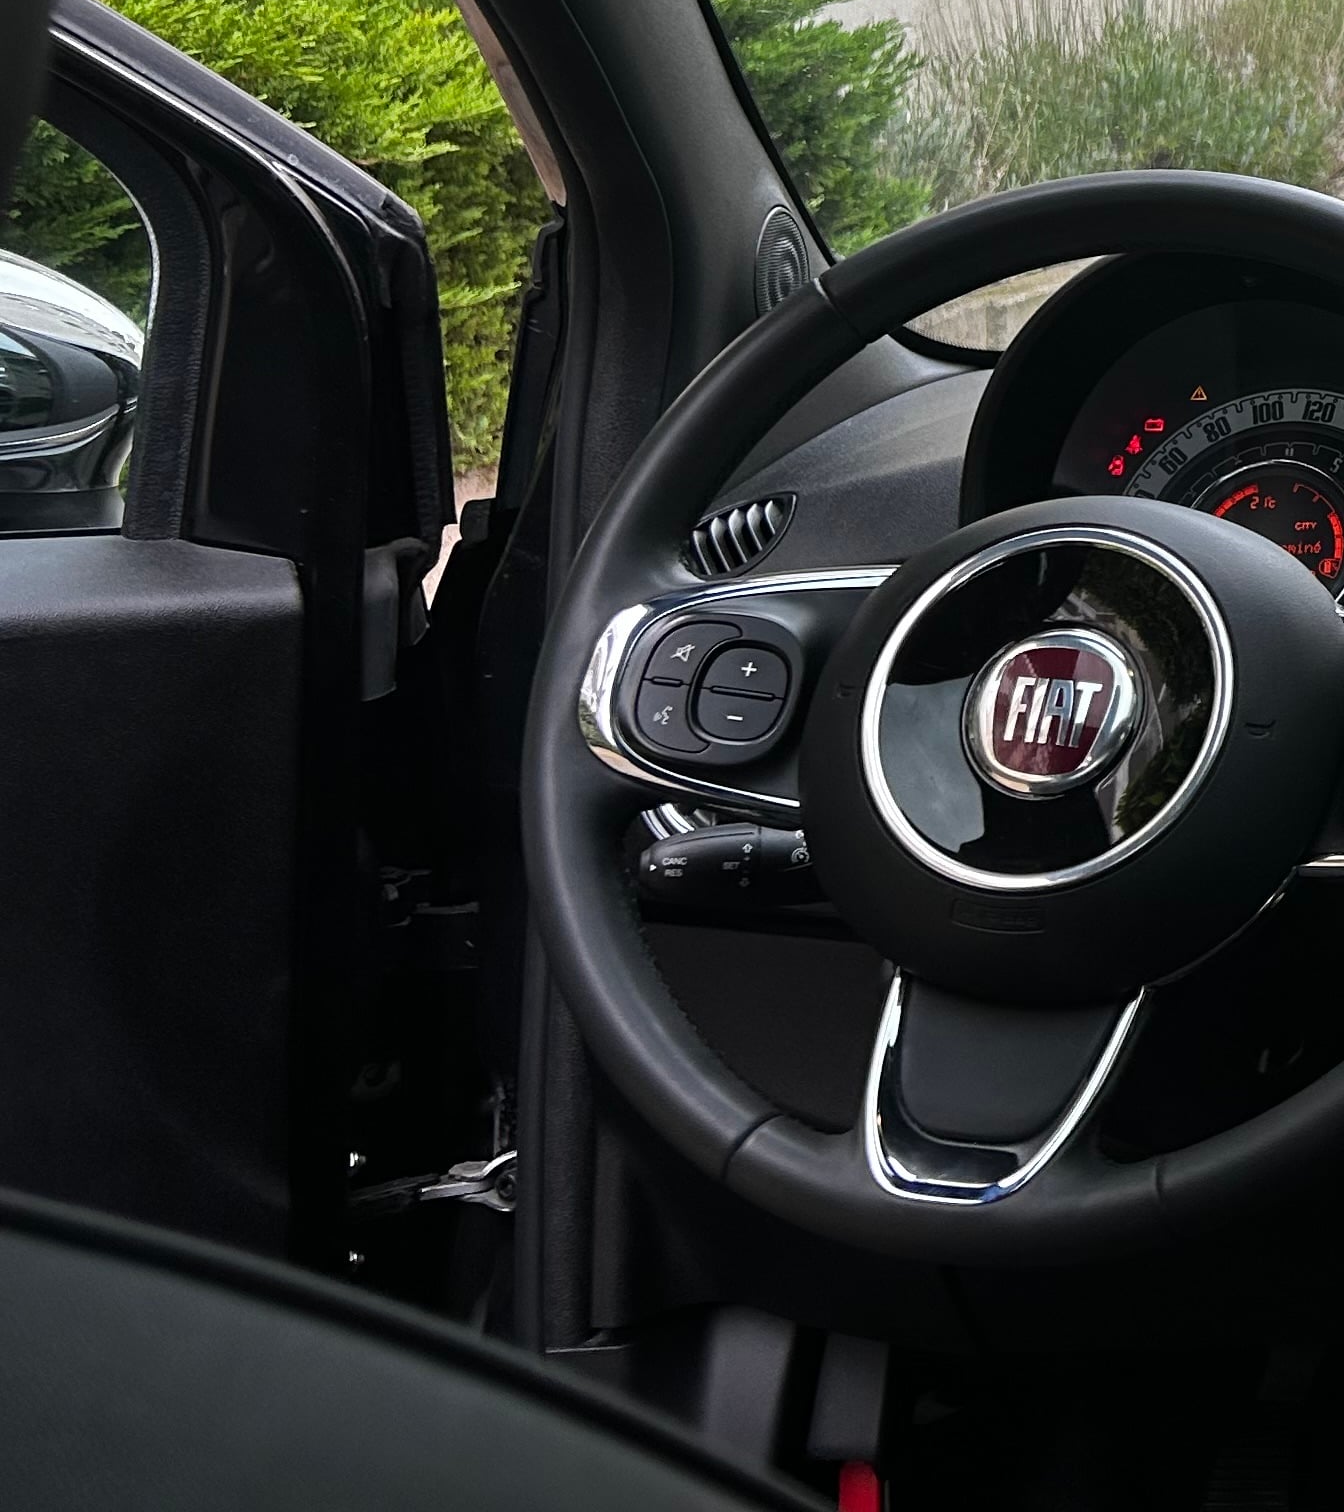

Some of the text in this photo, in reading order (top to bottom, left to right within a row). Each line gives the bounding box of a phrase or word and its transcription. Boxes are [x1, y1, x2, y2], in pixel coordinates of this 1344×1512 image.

[1251, 400, 1284, 425] 100
[1302, 399, 1337, 424] 120
[1202, 416, 1232, 443] 80
[1158, 447, 1188, 476] 60
[1294, 521, 1318, 531] CITY
[1003, 676, 1104, 748] FIAT
[661, 857, 688, 866] CANC
[664, 869, 683, 877] RES
[722, 861, 740, 870] SET
